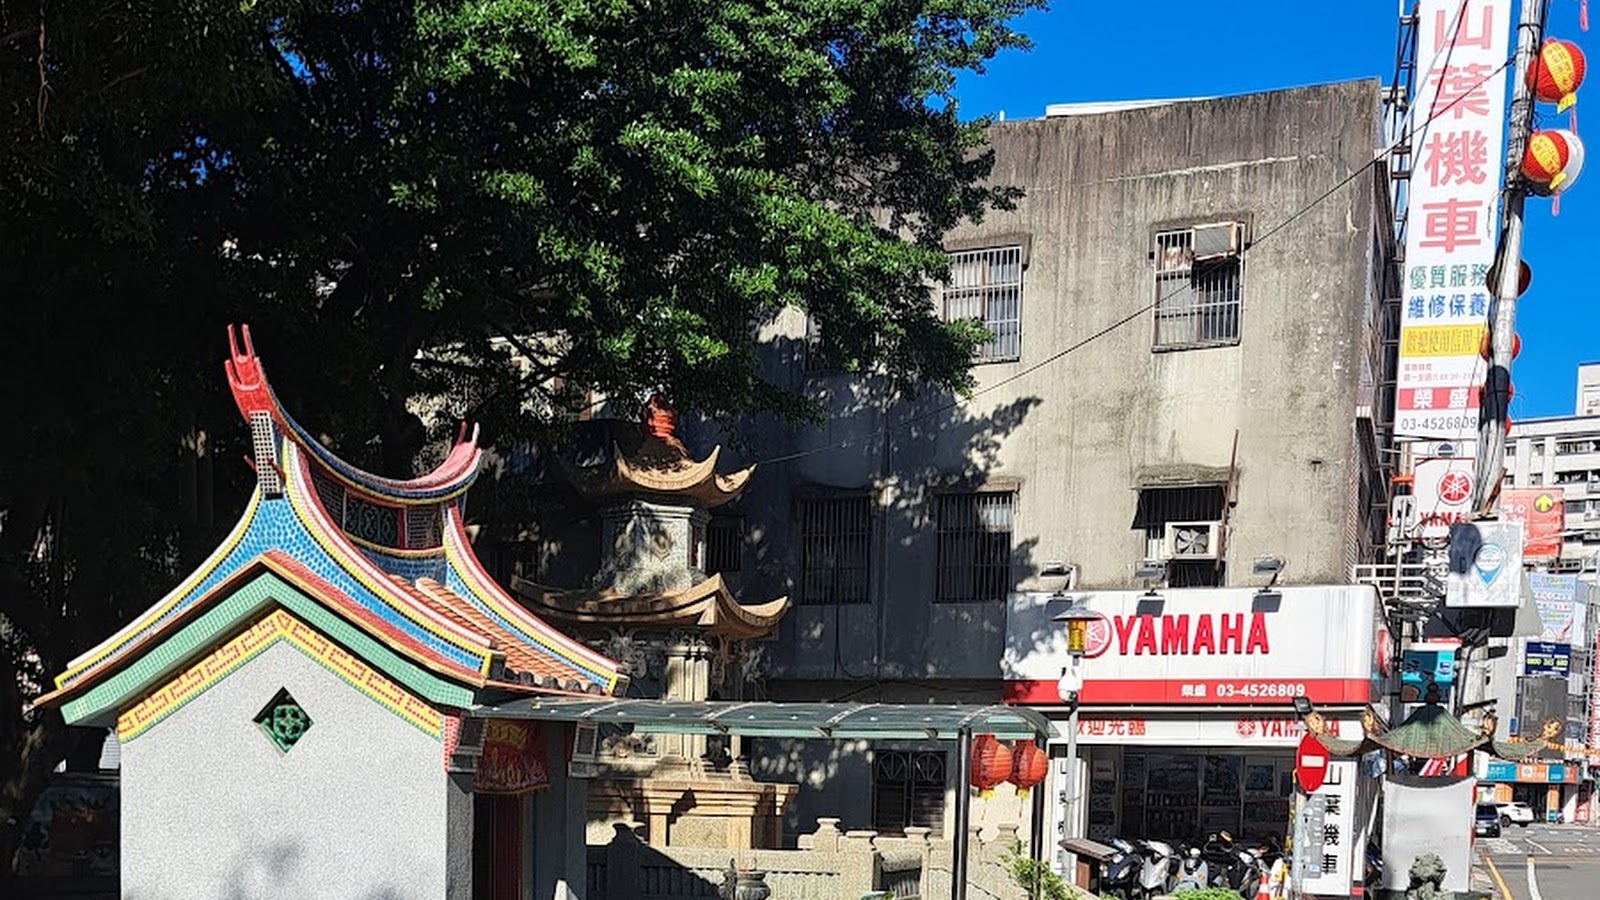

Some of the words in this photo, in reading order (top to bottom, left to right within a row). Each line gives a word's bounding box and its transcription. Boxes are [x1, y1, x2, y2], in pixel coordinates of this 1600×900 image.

[1419, 4, 1494, 254] 山葉機車
[1409, 263, 1488, 290] 優質服務
[1407, 292, 1487, 319] 維修保養
[1401, 416, 1477, 431] 03-4526809
[1420, 511, 1468, 527] YAMA
[1113, 612, 1270, 656] YAMAHA
[1216, 684, 1306, 698] 03-4526809
[1261, 717, 1340, 738] YAMA
